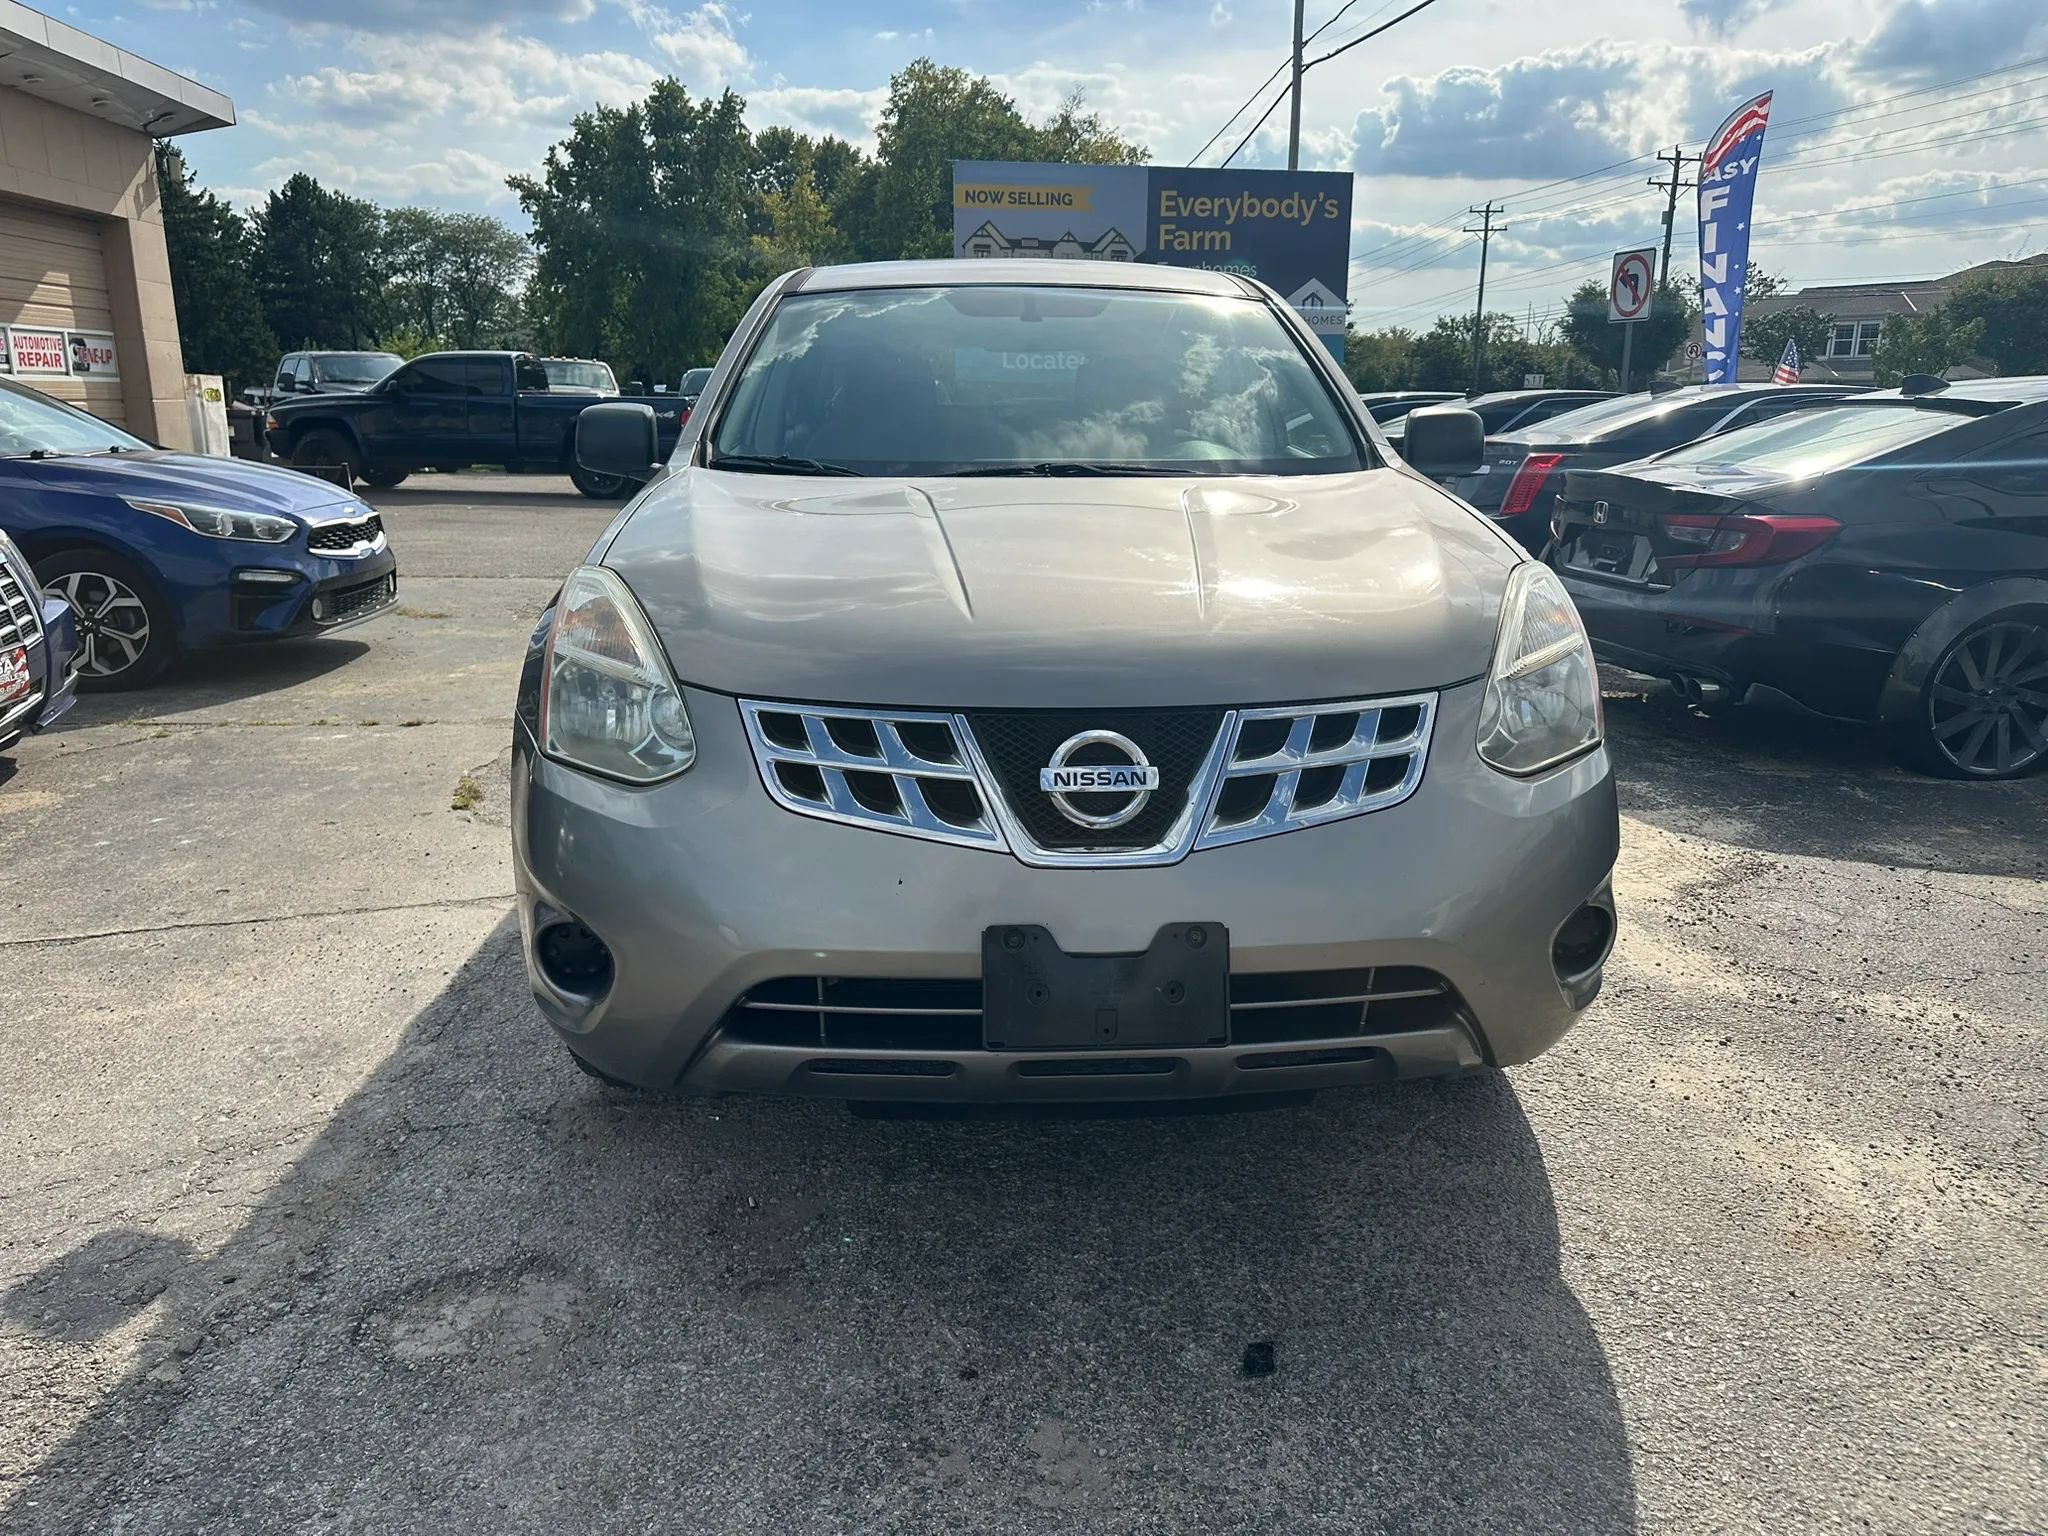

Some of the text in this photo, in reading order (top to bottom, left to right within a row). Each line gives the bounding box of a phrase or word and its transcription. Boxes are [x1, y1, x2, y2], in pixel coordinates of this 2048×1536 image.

[1702, 156, 1758, 185] ASY
[965, 190, 1073, 206] NOW SELLING
[1160, 190, 1339, 226] Everybody's
[1159, 224, 1232, 250] Farm
[1700, 185, 1730, 384] FINANC
[13, 335, 62, 351] AUTOMOTIVE
[18, 352, 62, 367] REPAIR
[1002, 351, 1088, 369] Locate
[1054, 771, 1147, 787] NISSAN
